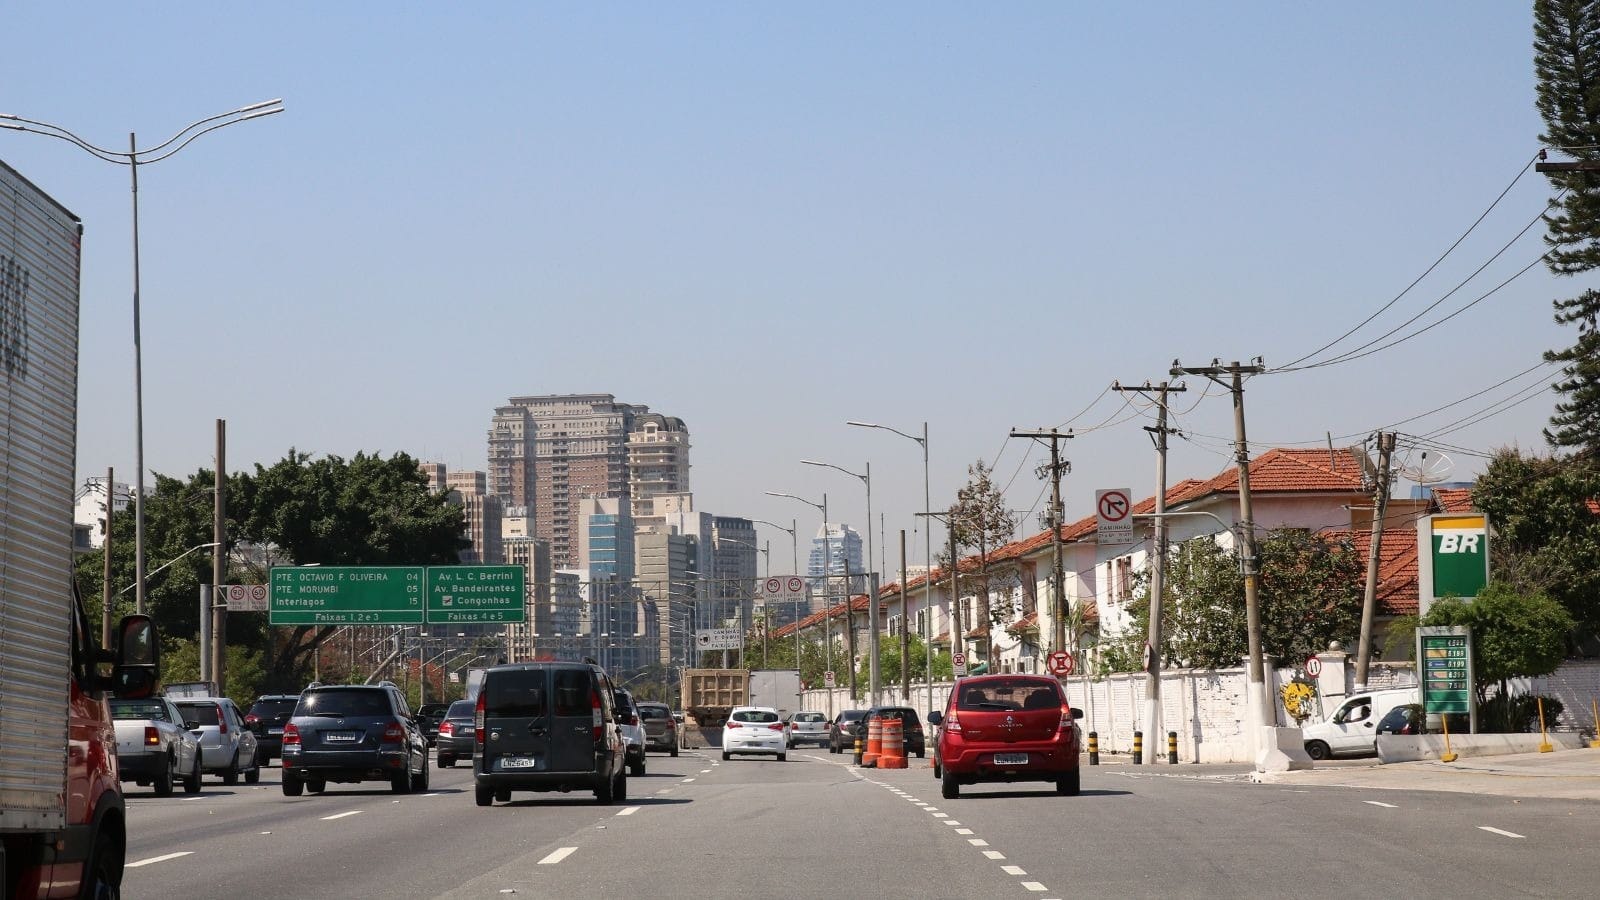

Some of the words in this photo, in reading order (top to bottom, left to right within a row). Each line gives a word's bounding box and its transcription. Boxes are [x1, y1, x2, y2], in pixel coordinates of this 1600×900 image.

[1438, 532, 1479, 553] BR
[276, 573, 295, 581] PTE.
[300, 573, 334, 581] OCTAVIO
[350, 573, 388, 581] OLIVEIRA
[406, 573, 418, 581] 04
[438, 572, 452, 580] Av.
[456, 572, 464, 580] L.
[467, 572, 477, 580] C.
[479, 572, 513, 580] Berrini
[299, 585, 339, 593] MORUMBI
[406, 585, 418, 593] 05
[434, 585, 449, 593] Av.
[452, 584, 516, 592] Bandeirantes
[276, 598, 325, 608] Interlagos
[409, 597, 418, 605] 15
[457, 597, 511, 606] Congonhas
[315, 613, 346, 621] Faixas
[373, 613, 379, 621] 3
[448, 612, 478, 621] Faixas
[480, 612, 487, 620] 4
[497, 612, 503, 620] 5
